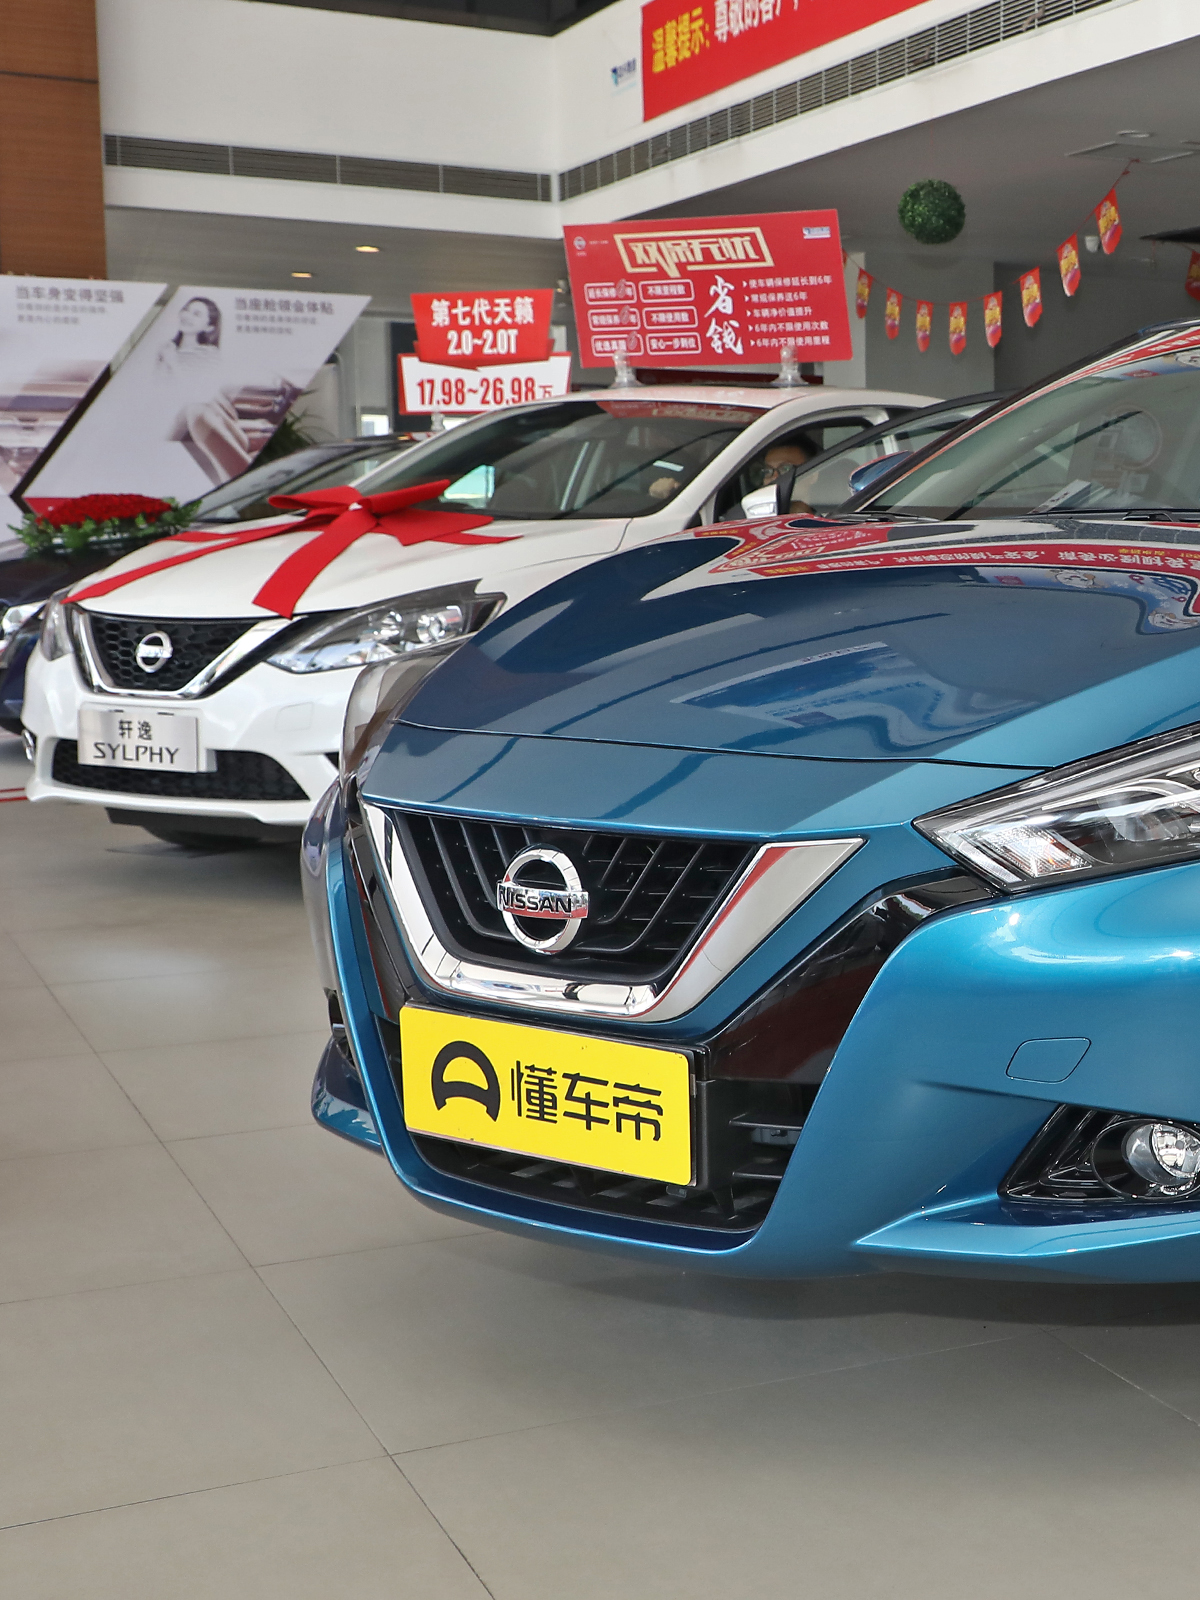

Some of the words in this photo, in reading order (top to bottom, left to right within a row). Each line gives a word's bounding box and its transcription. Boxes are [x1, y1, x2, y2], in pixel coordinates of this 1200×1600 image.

[628, 235, 760, 278] 双保无忧
[117, 718, 153, 741] 轩逸
[93, 742, 180, 764] SYLPHY
[498, 886, 574, 914] NISSAN
[510, 1060, 665, 1142] 懂车帝
